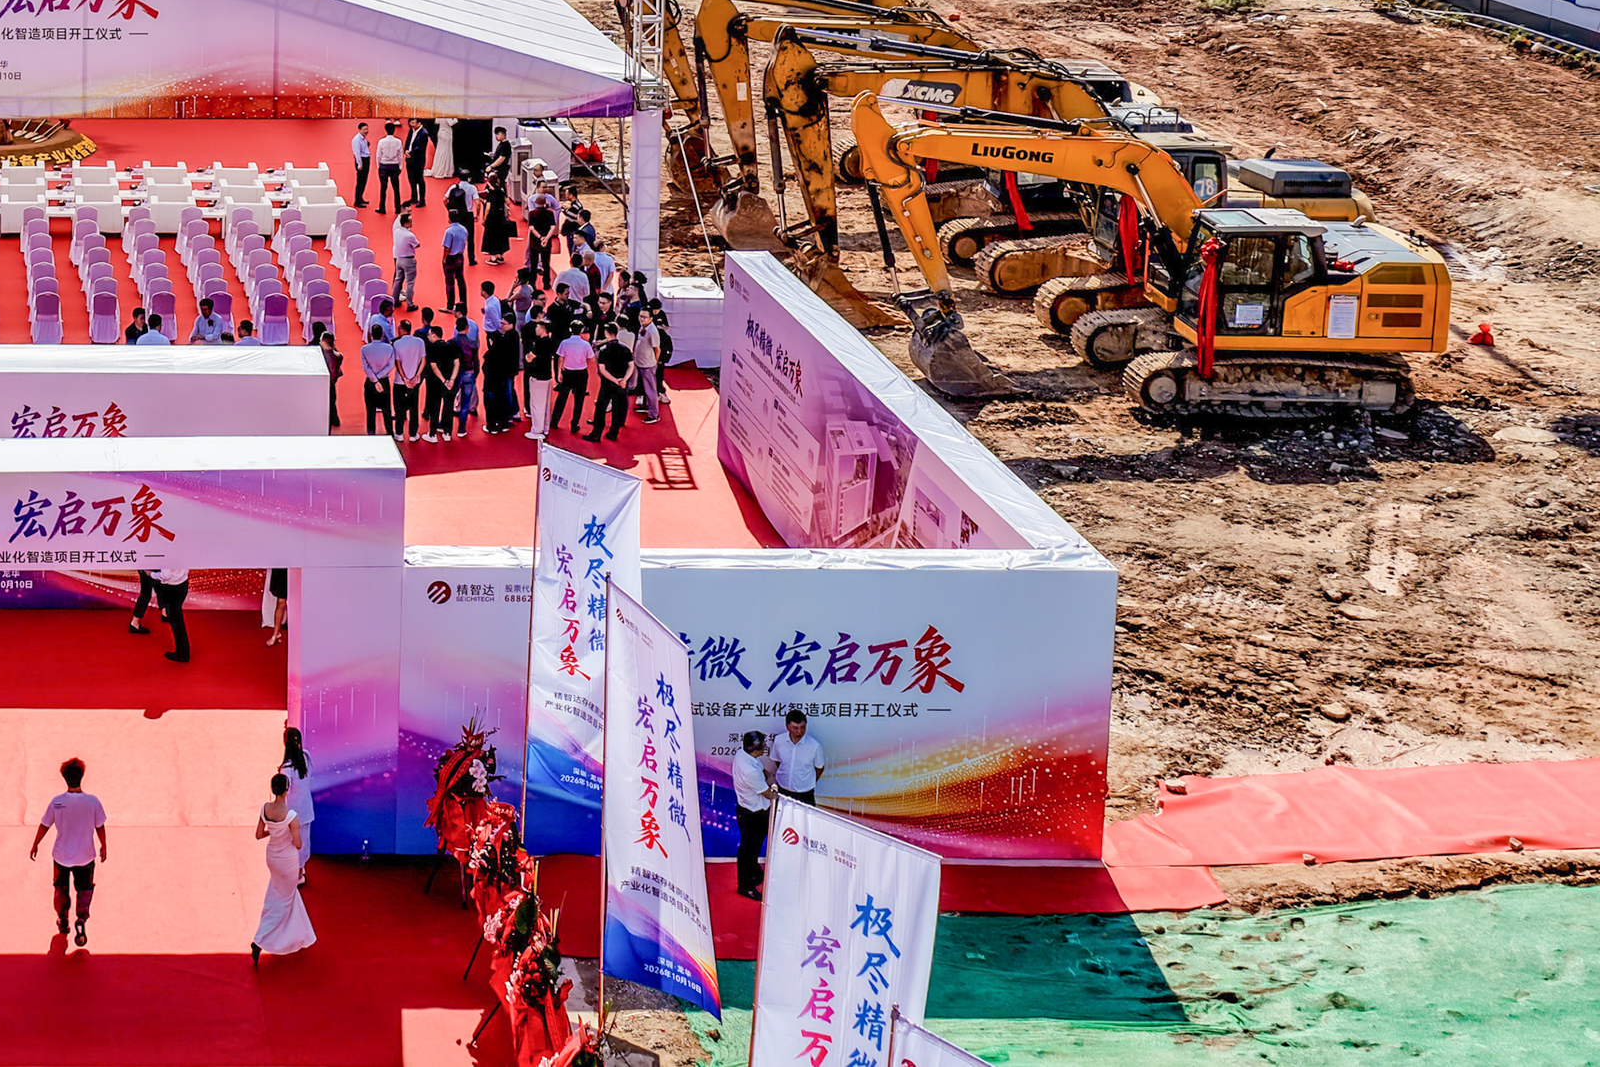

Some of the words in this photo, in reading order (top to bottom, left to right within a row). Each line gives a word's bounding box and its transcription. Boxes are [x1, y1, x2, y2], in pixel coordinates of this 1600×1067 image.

[902, 84, 955, 104] XCMG
[1196, 178, 1214, 197] 78
[10, 401, 127, 438] 宏启万象
[0, 485, 175, 544] 宏启万象
[456, 584, 495, 596] 精智达
[505, 584, 532, 593] 股票代
[556, 543, 591, 681] 宏启万象
[679, 632, 752, 690] 微
[768, 623, 966, 694] 宏启万象
[633, 695, 669, 859] 宏启万象
[655, 671, 692, 843] 极尽精微
[644, 963, 702, 994] 2026年10月10日
